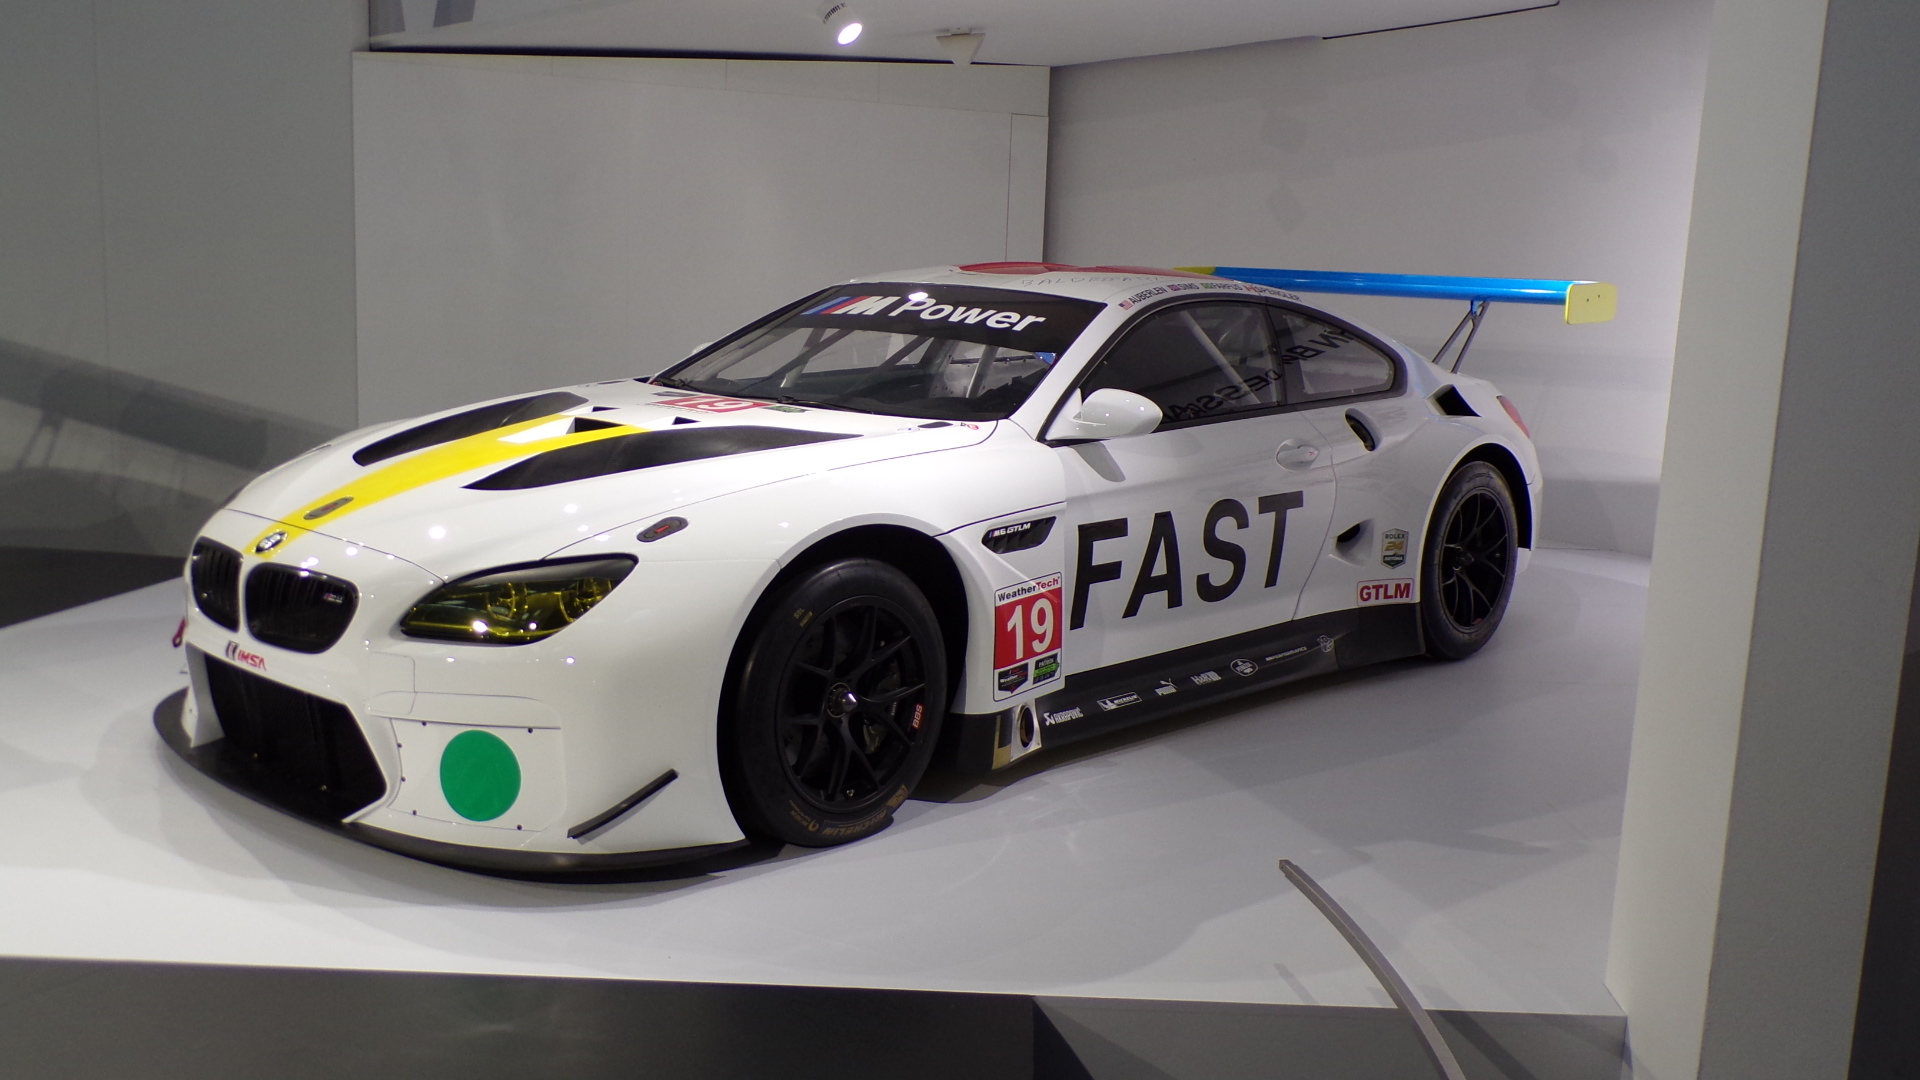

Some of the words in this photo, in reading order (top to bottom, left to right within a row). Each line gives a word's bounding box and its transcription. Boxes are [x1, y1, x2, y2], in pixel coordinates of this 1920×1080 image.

[1130, 286, 1167, 305] AUBERLEN
[1178, 282, 1200, 291] SIMS
[828, 296, 901, 315] M
[889, 298, 1047, 331] Power
[1006, 522, 1031, 534] GTLM
[1384, 541, 1404, 551] 24
[1069, 490, 1304, 630] FAST
[1360, 583, 1411, 602] GTLM
[1007, 597, 1054, 660] 19
[237, 650, 267, 671] IMSA
[912, 704, 923, 728] BBS
[821, 809, 887, 835] MICHELIN
